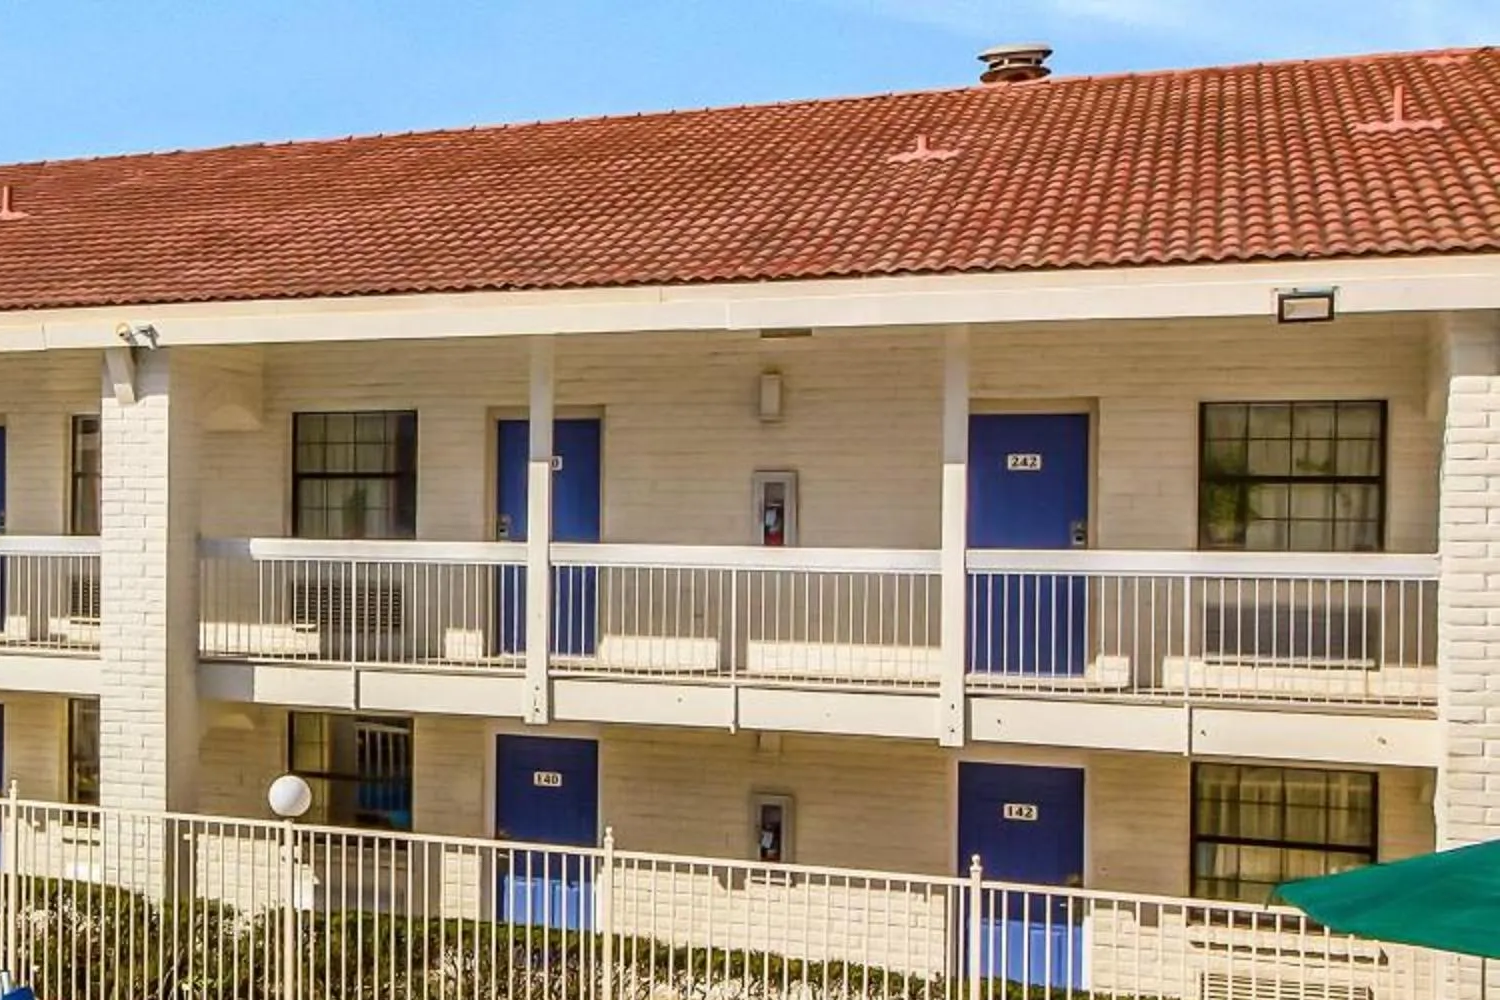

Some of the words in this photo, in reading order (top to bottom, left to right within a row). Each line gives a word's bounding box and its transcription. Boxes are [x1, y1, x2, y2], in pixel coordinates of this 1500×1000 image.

[1011, 455, 1038, 468] 242
[537, 773, 560, 785] 140
[1007, 805, 1034, 819] 142
